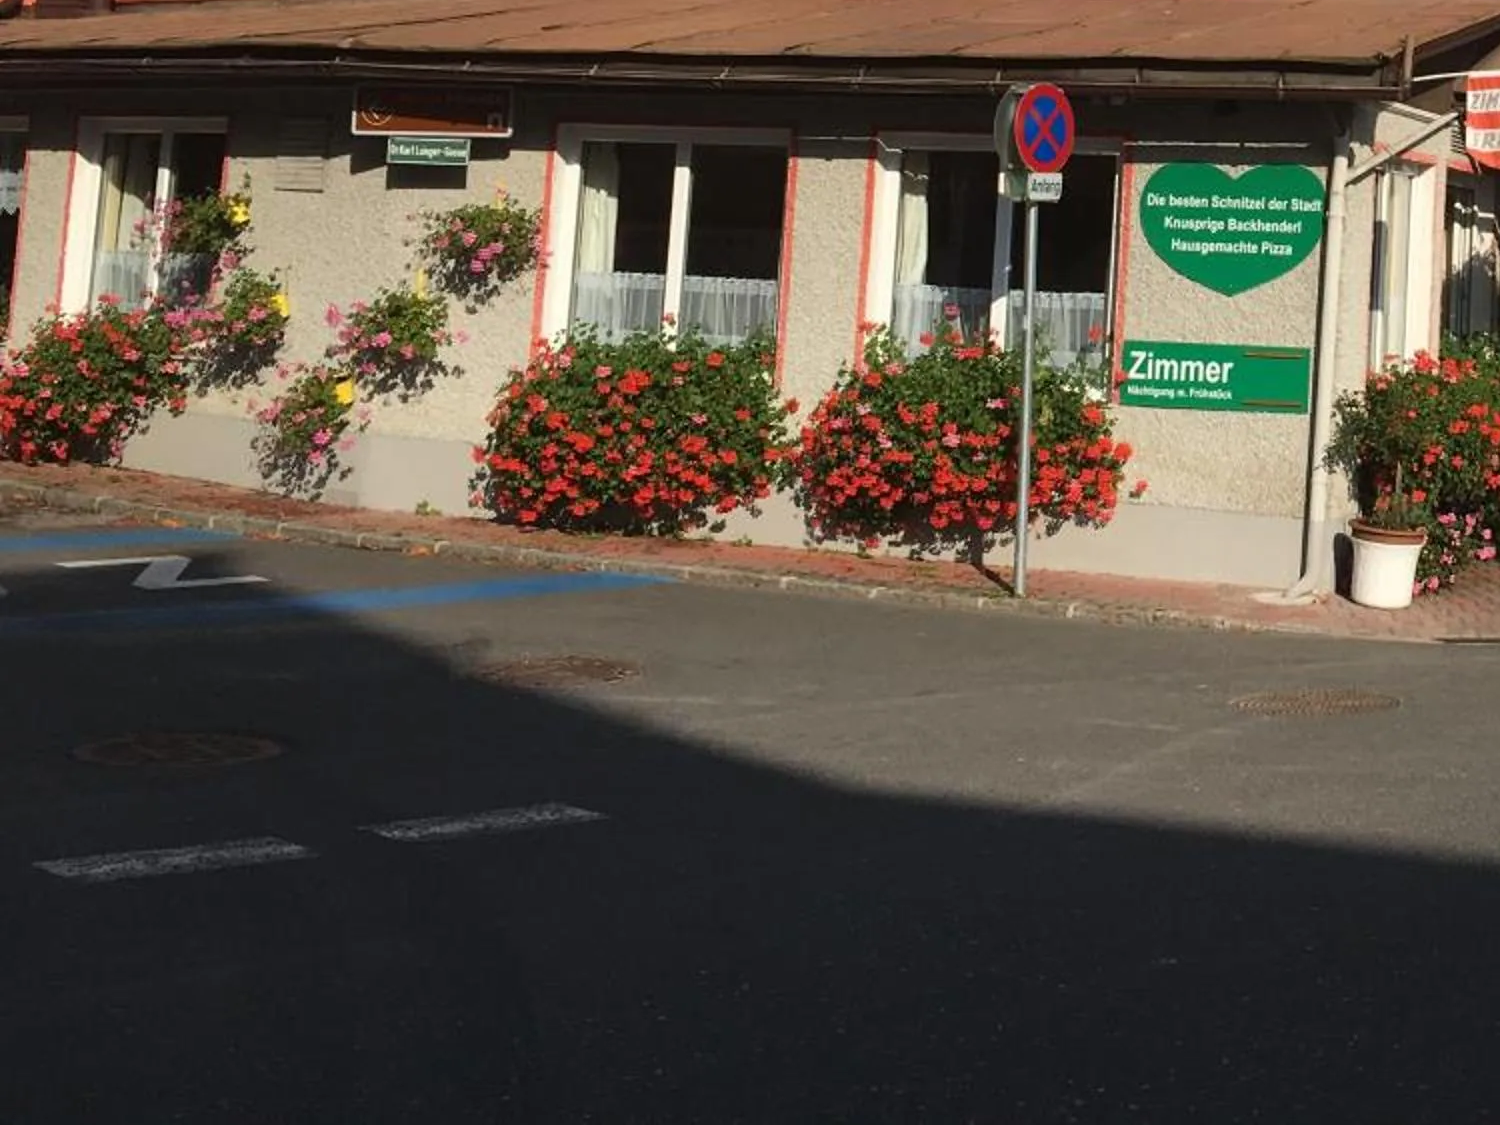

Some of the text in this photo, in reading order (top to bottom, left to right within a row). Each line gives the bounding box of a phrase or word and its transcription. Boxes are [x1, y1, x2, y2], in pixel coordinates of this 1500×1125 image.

[1147, 193, 1322, 213] Die besten Schnitzel der Stadt
[1164, 216, 1302, 234] Knusprige Backhenderl
[1171, 238, 1293, 256] Hausgemachte Pizza
[1127, 351, 1234, 384] Zimmer
